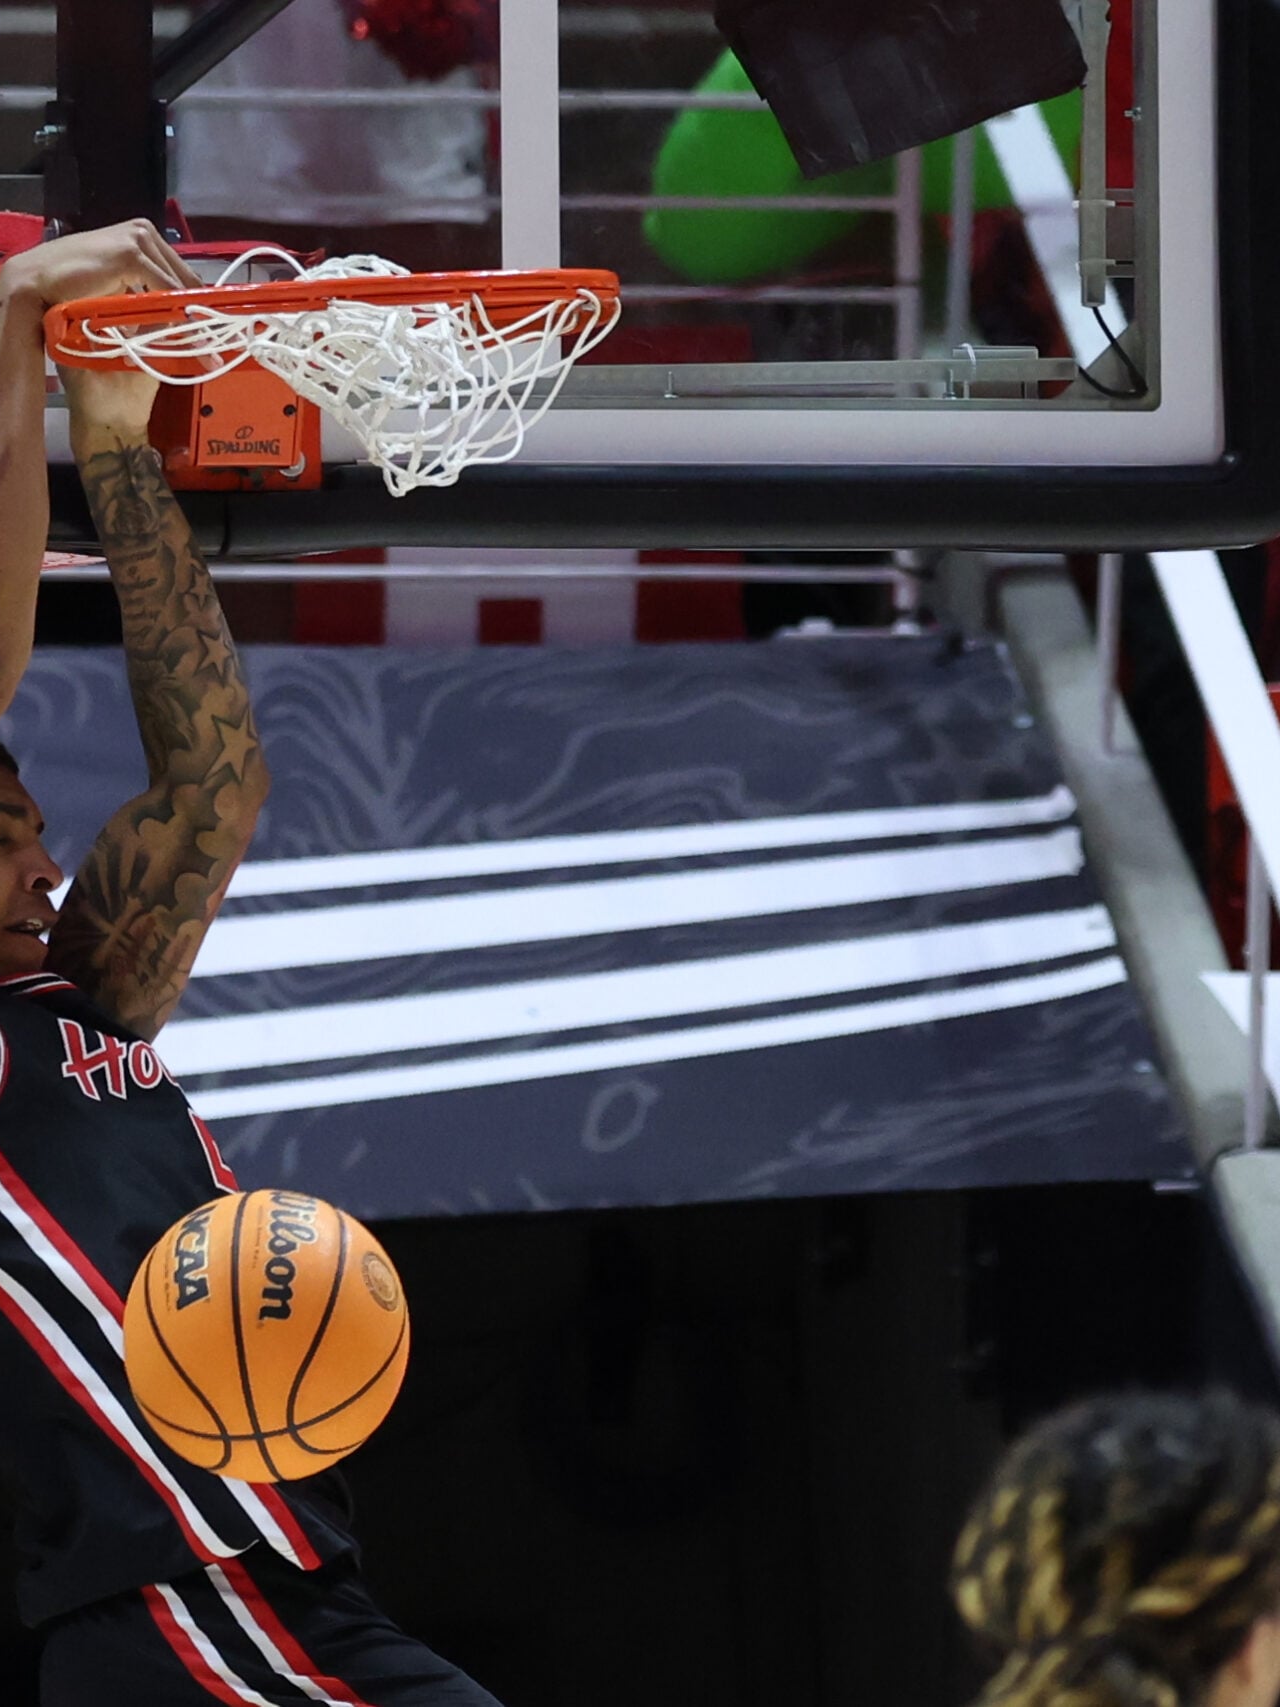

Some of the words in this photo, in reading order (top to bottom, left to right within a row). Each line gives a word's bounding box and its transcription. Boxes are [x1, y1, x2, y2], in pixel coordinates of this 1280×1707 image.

[207, 439, 281, 456] SPALDING
[58, 1017, 178, 1101] Ho
[174, 1205, 217, 1311] NCAA
